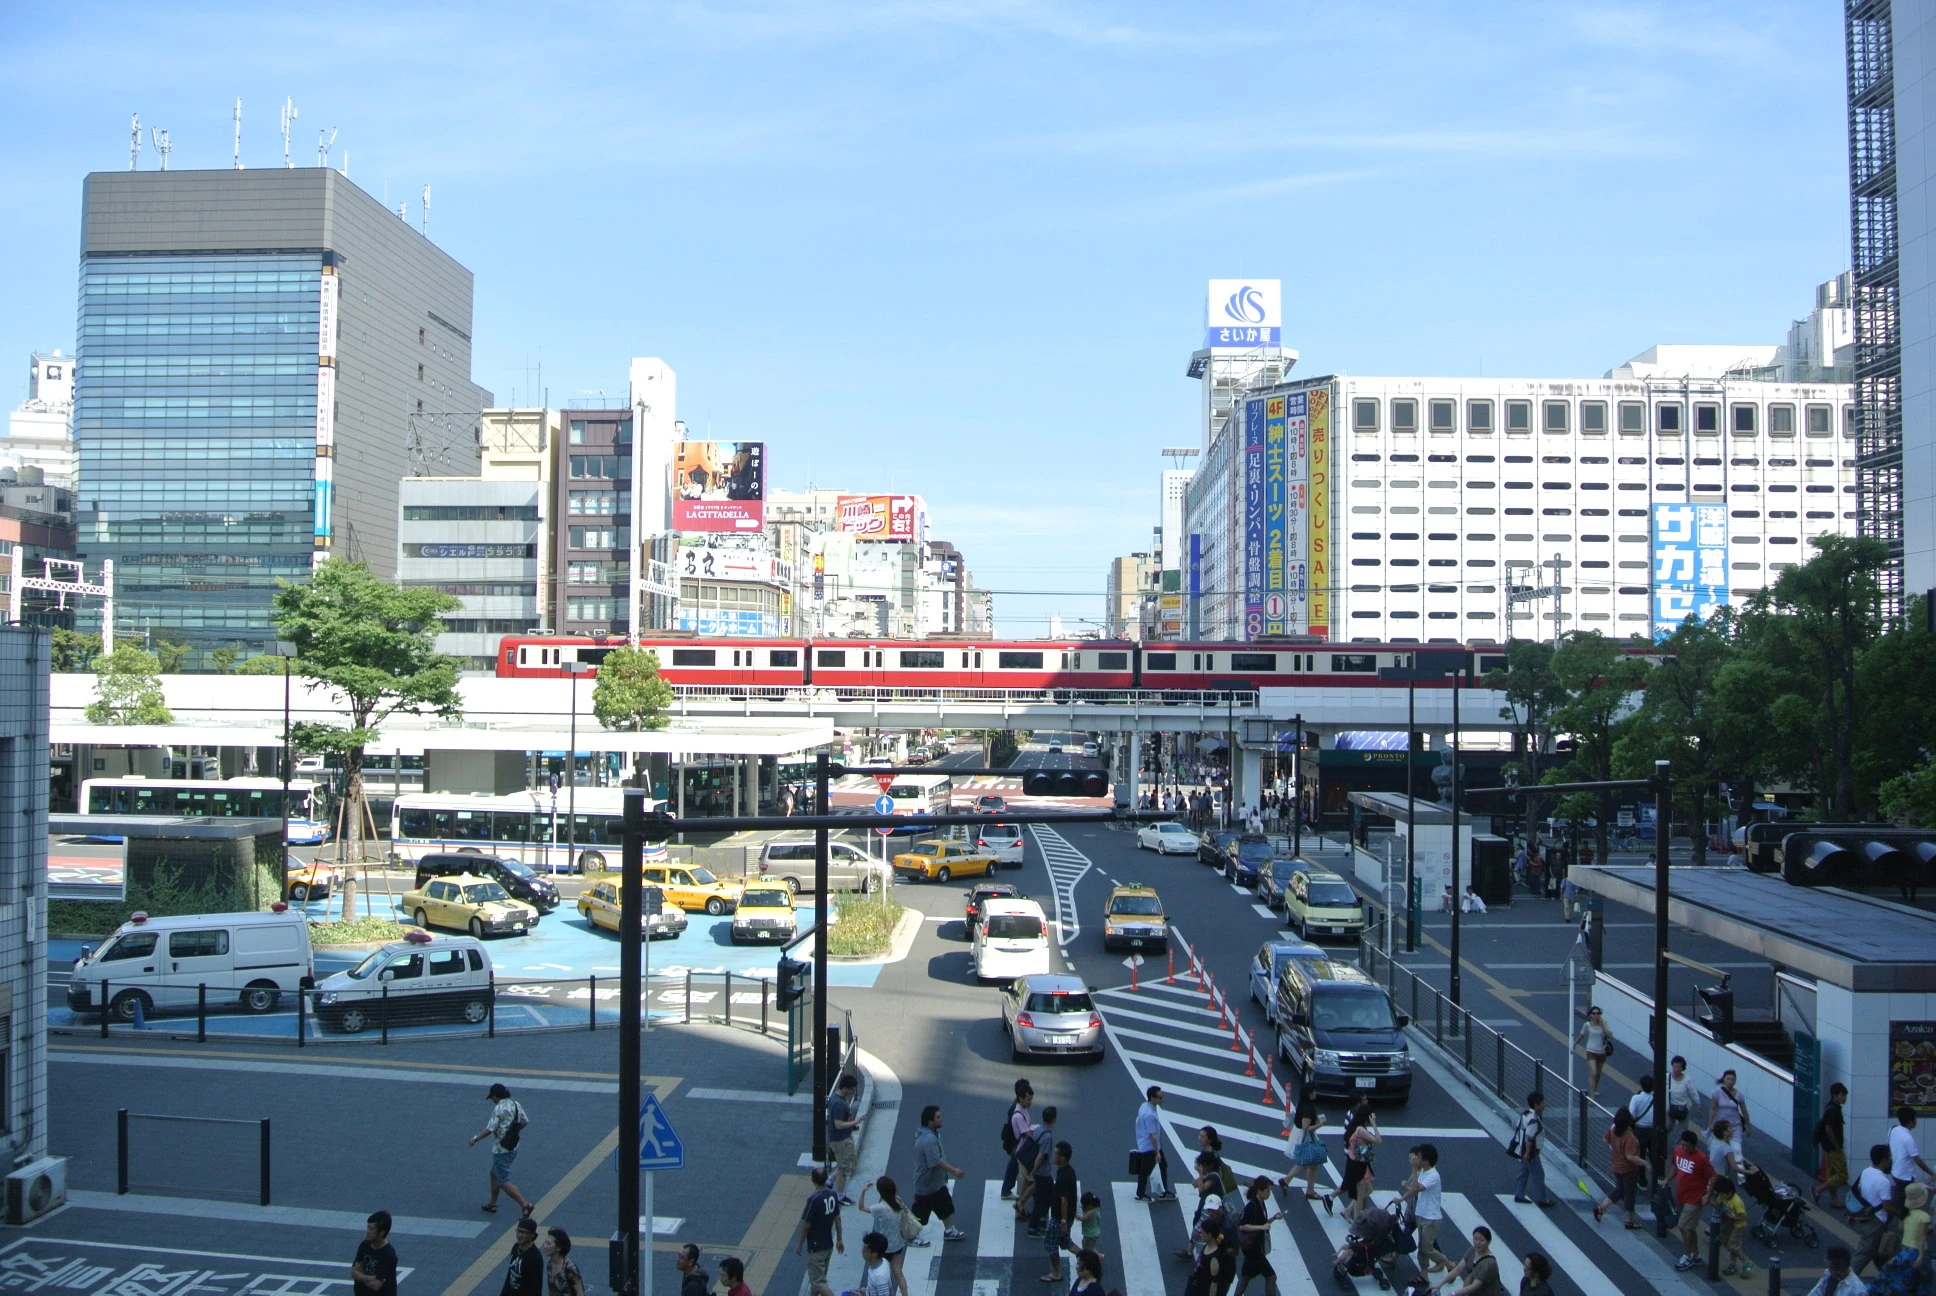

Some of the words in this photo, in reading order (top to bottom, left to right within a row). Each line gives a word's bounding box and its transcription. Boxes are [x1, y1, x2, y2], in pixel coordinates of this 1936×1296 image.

[1220, 327, 1271, 342] さいか屋
[1268, 400, 1283, 415] 4F
[1289, 395, 1304, 406] 営業
[750, 446, 761, 496] 遊ぼーの。
[1268, 423, 1284, 522] 紳士スーツ
[686, 511, 697, 519] LA
[697, 511, 750, 519] CITTADELLA
[843, 503, 872, 518] 川崎
[892, 519, 905, 533] 右
[1268, 529, 1283, 589] 2着目
[1656, 505, 1695, 632] サカゼ
[687, 620, 757, 634] サークルホーム
[823, 1195, 836, 1216] 10
